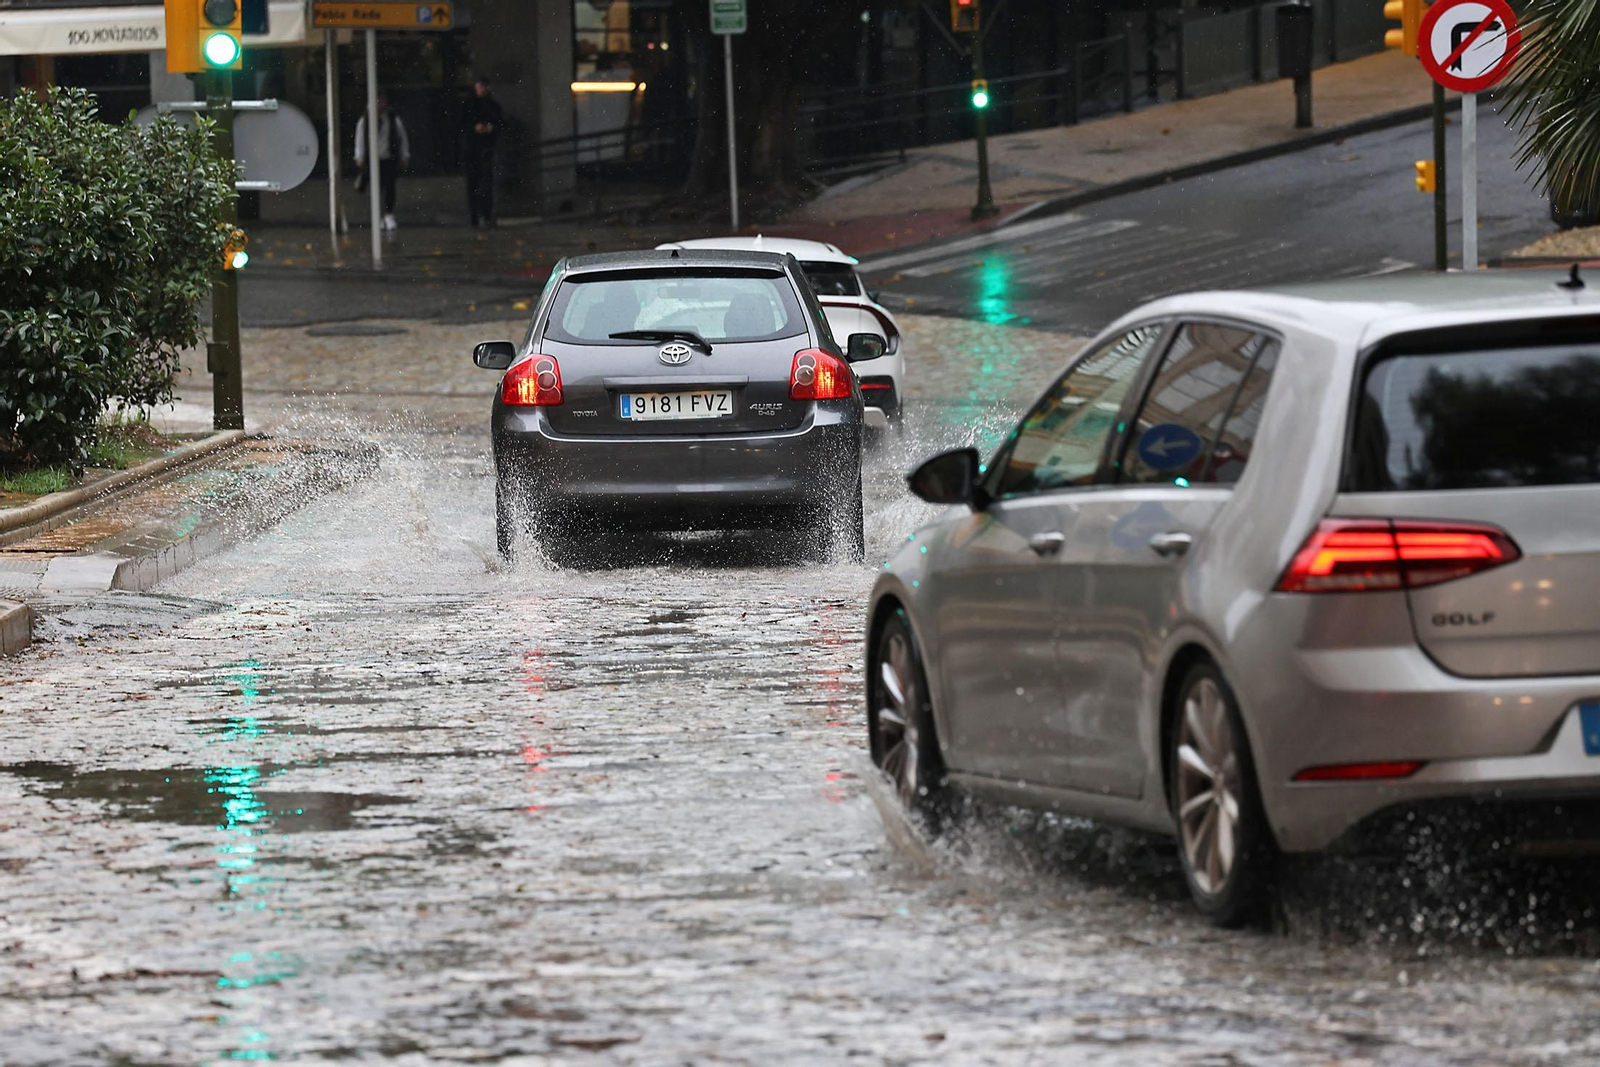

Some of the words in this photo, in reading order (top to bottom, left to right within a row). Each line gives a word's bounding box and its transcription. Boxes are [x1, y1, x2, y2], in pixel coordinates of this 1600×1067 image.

[68, 30, 90, 45] 100
[635, 395, 681, 413] 9181
[691, 394, 728, 412] FVZ
[1431, 611, 1496, 627] GOLF
